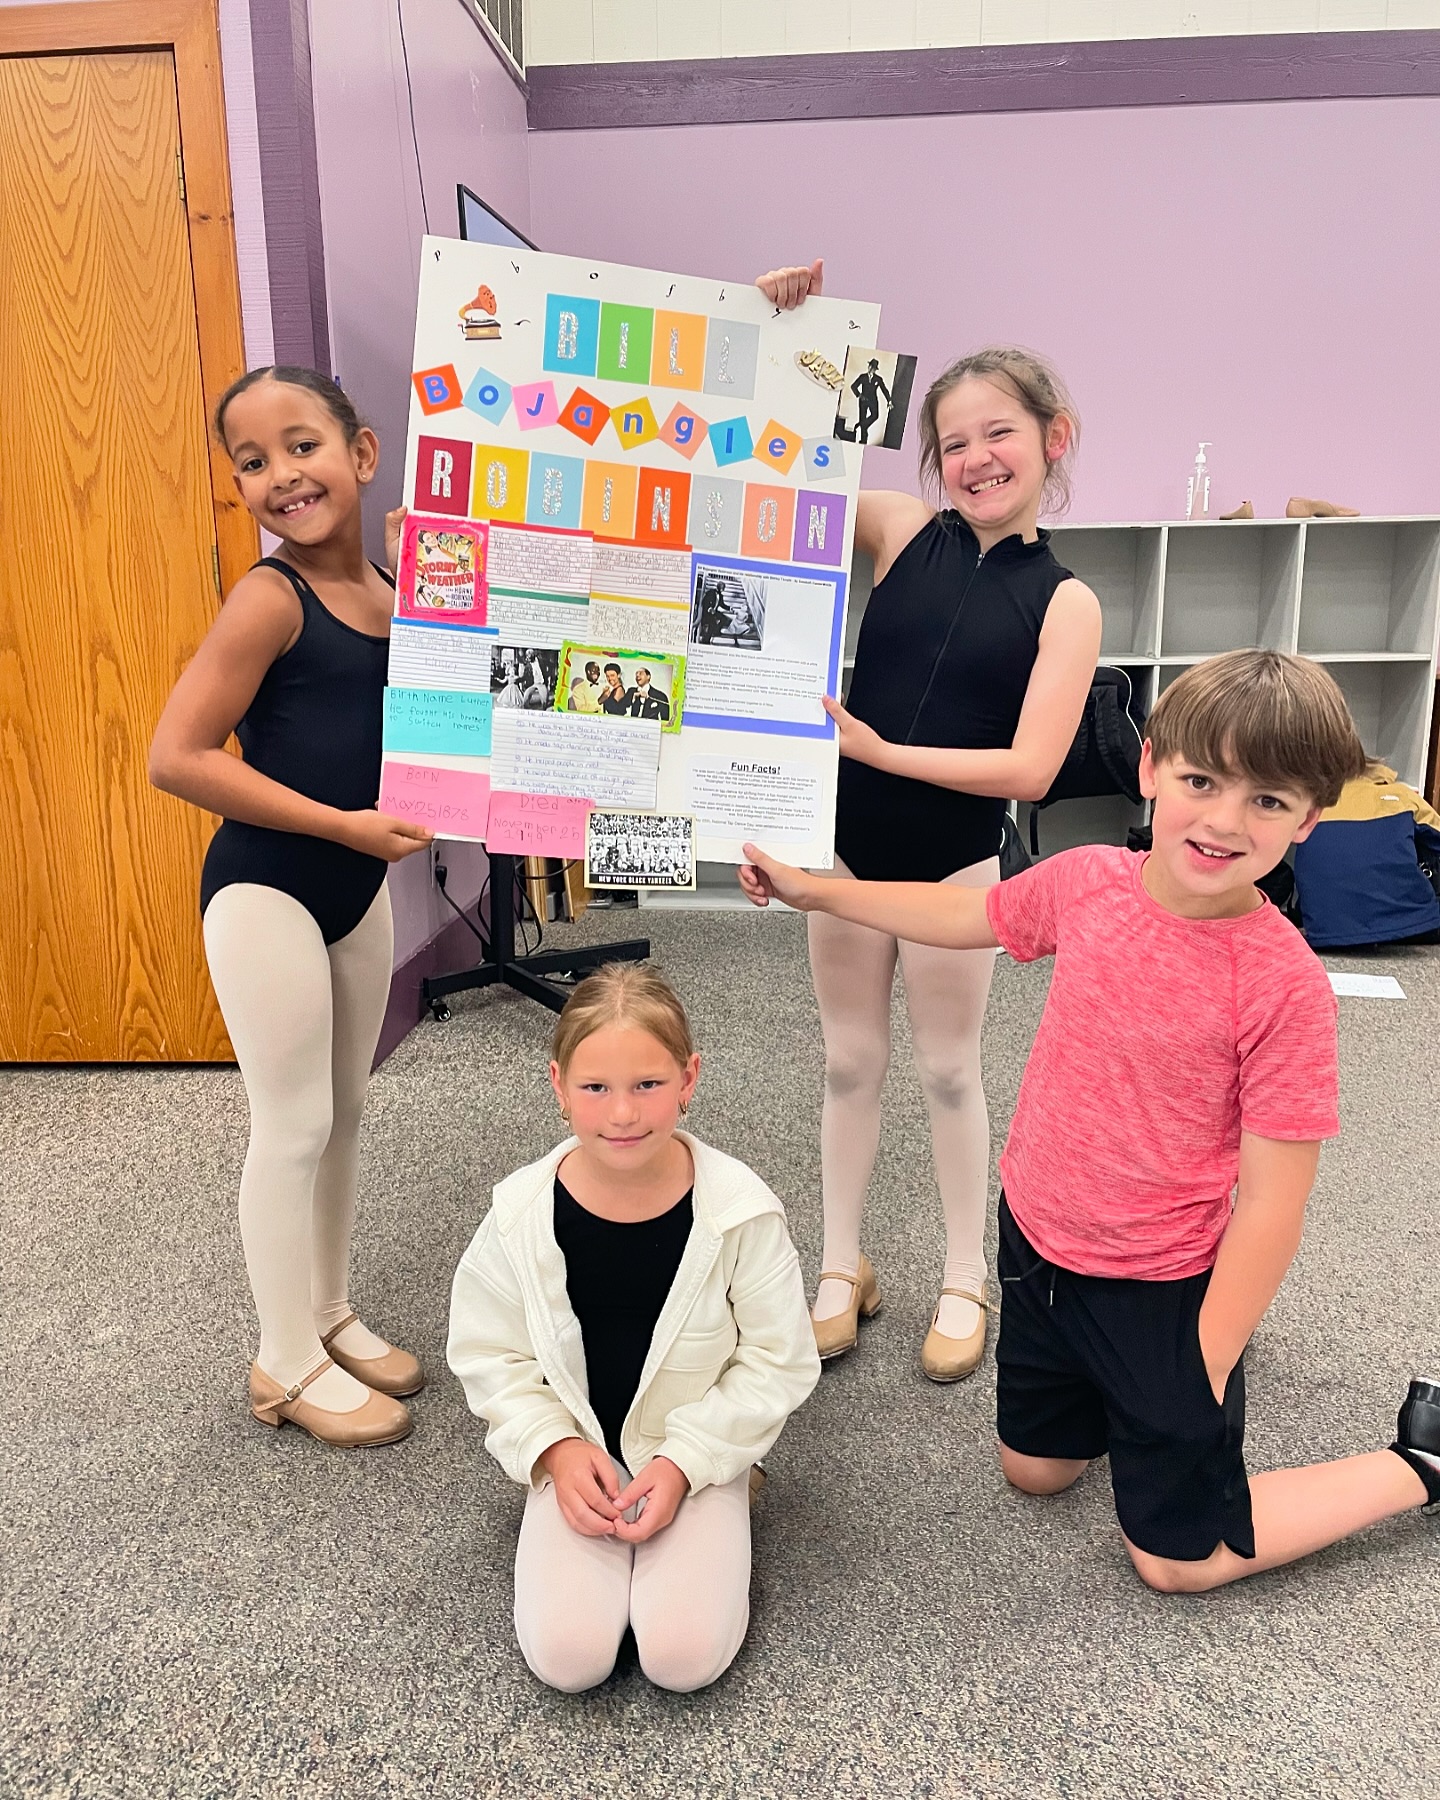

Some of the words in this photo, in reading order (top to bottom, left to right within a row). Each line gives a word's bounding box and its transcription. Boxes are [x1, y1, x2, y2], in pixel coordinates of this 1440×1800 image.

[557, 311, 736, 384] BILL
[432, 449, 828, 550] ROBINSON
[416, 559, 458, 576] STORMY
[428, 573, 473, 587] WEATHER
[390, 690, 419, 702] Birth
[423, 693, 453, 704] Name
[461, 695, 490, 707] Luther
[389, 703, 404, 714] He
[731, 762, 749, 772] Fun
[751, 763, 781, 775] Facts!
[520, 794, 559, 810] Died
[494, 818, 557, 835] November
[598, 875, 611, 883] NEW
[612, 876, 627, 884] YORK
[628, 876, 646, 884] BLACK
[647, 877, 672, 885] YANKEES
